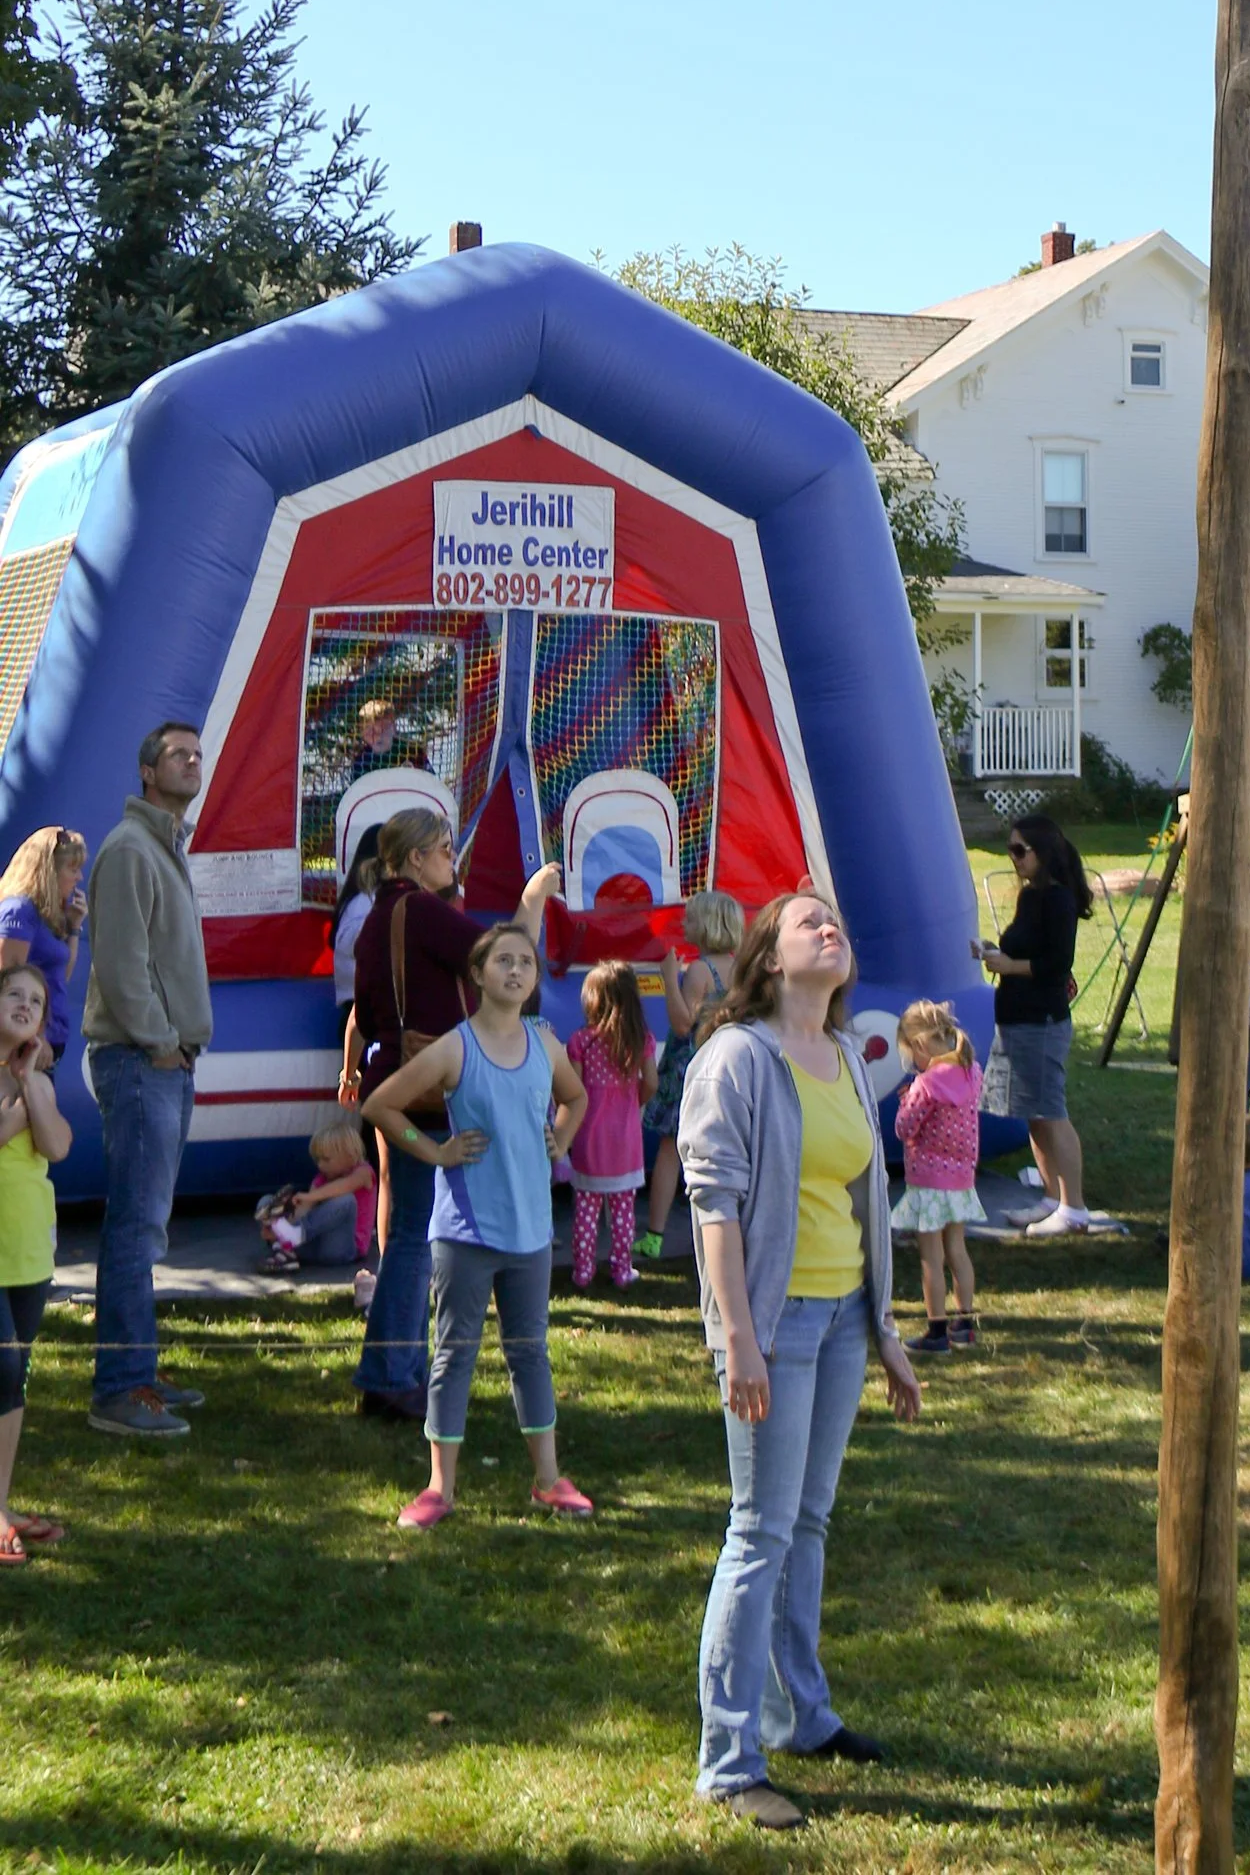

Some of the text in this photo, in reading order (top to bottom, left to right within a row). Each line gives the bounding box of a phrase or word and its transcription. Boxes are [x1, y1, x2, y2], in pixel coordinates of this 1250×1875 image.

[472, 491, 573, 528] Jerihill
[437, 535, 609, 570] Home Center
[436, 572, 612, 608] 802-899-1277
